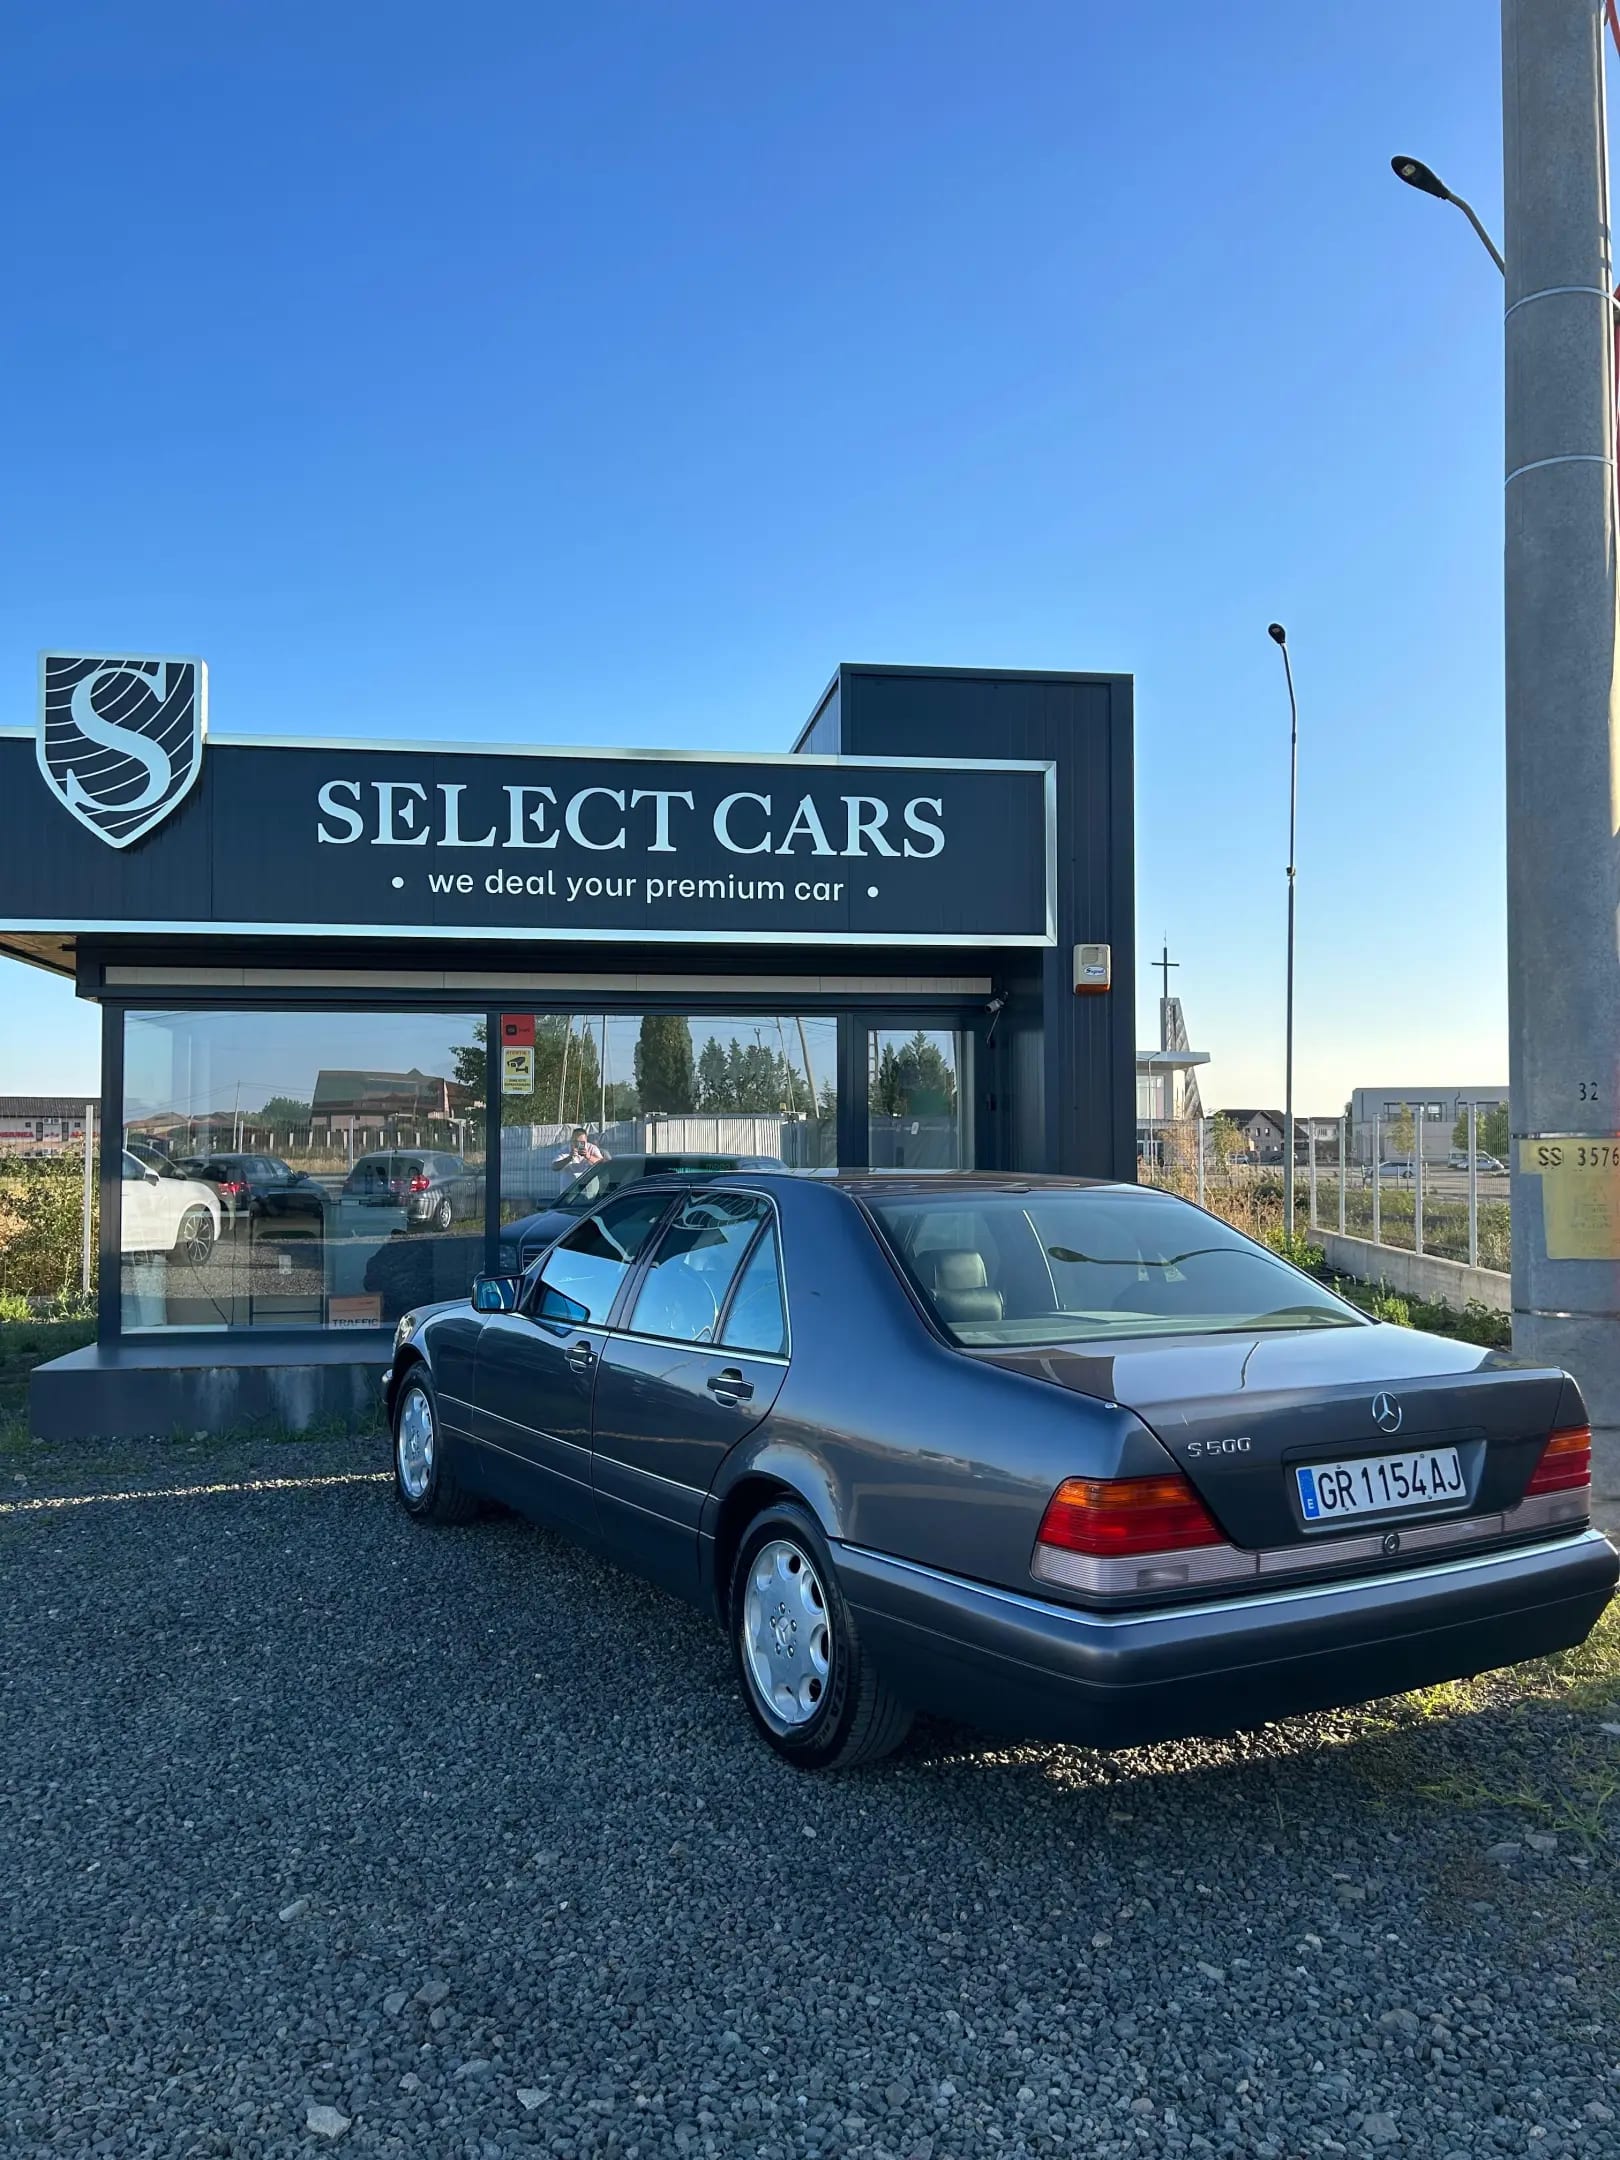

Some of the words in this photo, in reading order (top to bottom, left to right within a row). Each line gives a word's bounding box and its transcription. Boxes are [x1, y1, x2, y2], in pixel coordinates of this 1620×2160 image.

[67, 667, 171, 812] S
[317, 780, 695, 852] SELECT
[713, 792, 946, 859] CARS
[428, 874, 474, 894] we
[485, 868, 556, 896] deal
[566, 876, 637, 902] your
[646, 873, 785, 904] premium
[794, 881, 844, 902] car
[1579, 1082, 1599, 1101] 32
[1538, 1147, 1562, 1166] SS
[1577, 1147, 1620, 1167] 3576
[1206, 1437, 1252, 1456] 500
[1307, 1498, 1315, 1510] E
